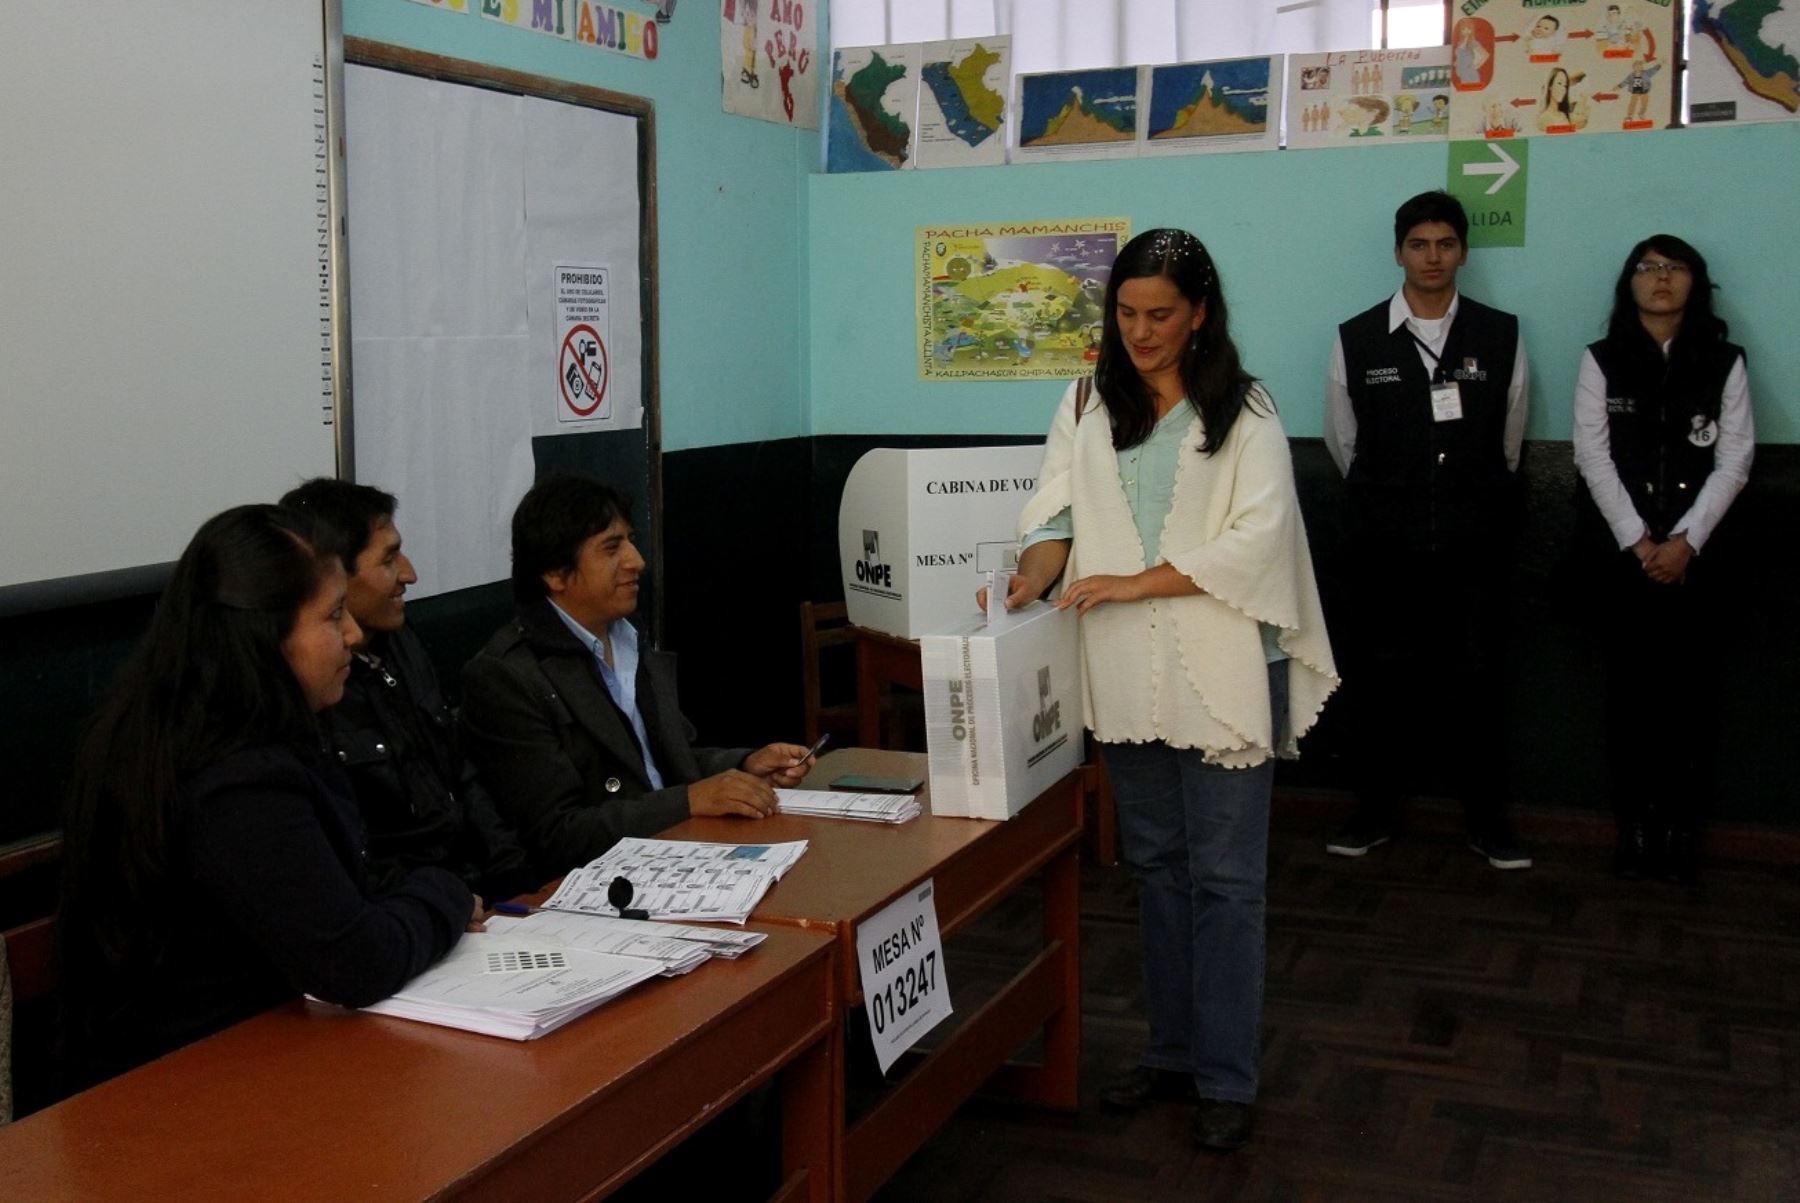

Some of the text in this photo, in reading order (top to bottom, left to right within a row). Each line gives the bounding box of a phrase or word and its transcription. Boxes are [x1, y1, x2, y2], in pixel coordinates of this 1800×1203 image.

[531, 0, 565, 35] MI
[577, 0, 659, 60] AMIGO
[924, 221, 1127, 240] PACHA MAMANCHIS
[1471, 210, 1513, 226] LIDA
[560, 272, 603, 285] PROHIBIDO
[1693, 430, 1710, 442] 16
[926, 479, 986, 495] CABINA
[989, 478, 1009, 492] DE
[856, 559, 892, 588] ONPE
[916, 553, 956, 567] MESA
[949, 679, 967, 742] ONPE
[967, 715, 976, 725] DE
[1033, 700, 1061, 743] ONPE
[968, 727, 978, 758] NACIONAL
[971, 759, 981, 786] OFICINA
[872, 927, 911, 974] MESA
[872, 949, 936, 1035] 013247
